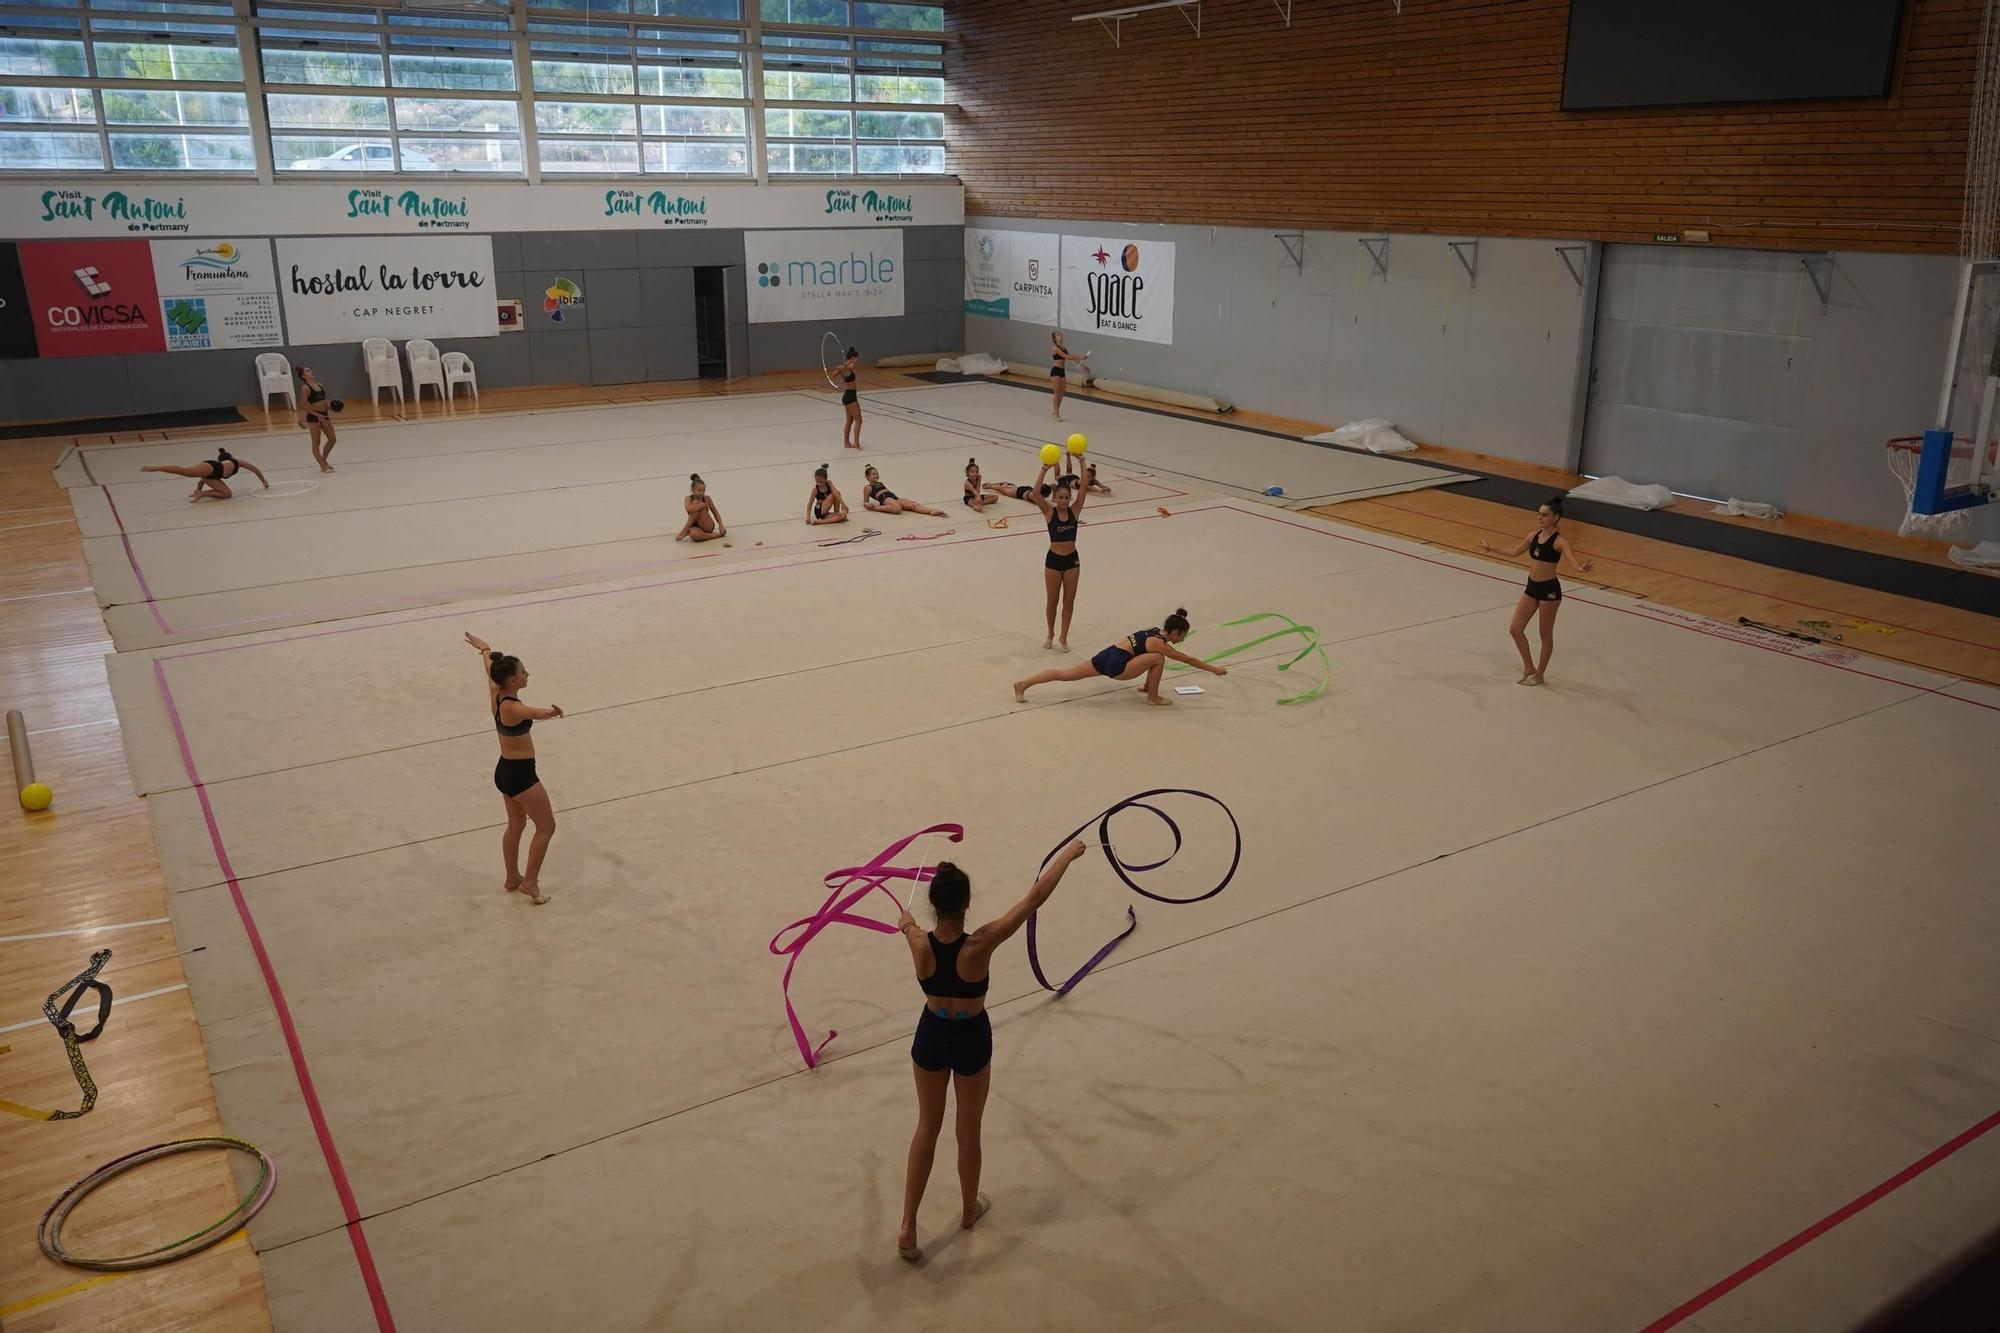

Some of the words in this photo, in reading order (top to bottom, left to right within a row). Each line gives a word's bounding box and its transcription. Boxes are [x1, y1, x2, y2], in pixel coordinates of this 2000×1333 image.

[58, 191, 82, 199] Visit
[825, 190, 859, 214] Sant
[862, 190, 913, 214] Antoni
[41, 190, 97, 222] Sant
[102, 191, 187, 222] Antoni
[347, 189, 393, 218] Sant
[398, 190, 468, 219] Antoni
[605, 190, 644, 216] Sant
[647, 191, 707, 217] Antoni
[128, 223, 140, 231] de
[142, 223, 189, 233] Portmany
[431, 220, 470, 229] Portmany
[675, 218, 708, 226] Portmany
[186, 265, 249, 280] Tramuntana
[788, 252, 894, 286] marble
[291, 264, 373, 295] hostal
[380, 264, 408, 291] la
[411, 266, 485, 291] torre
[801, 291, 832, 299] STELLA
[1013, 281, 1053, 296] CARPINTSA
[1086, 271, 1144, 330] space
[48, 304, 147, 326] COVICSA
[353, 308, 378, 317] CAP
[385, 305, 434, 315] NEGRET
[1101, 319, 1111, 327] EAT
[1118, 321, 1137, 331] DANCE
